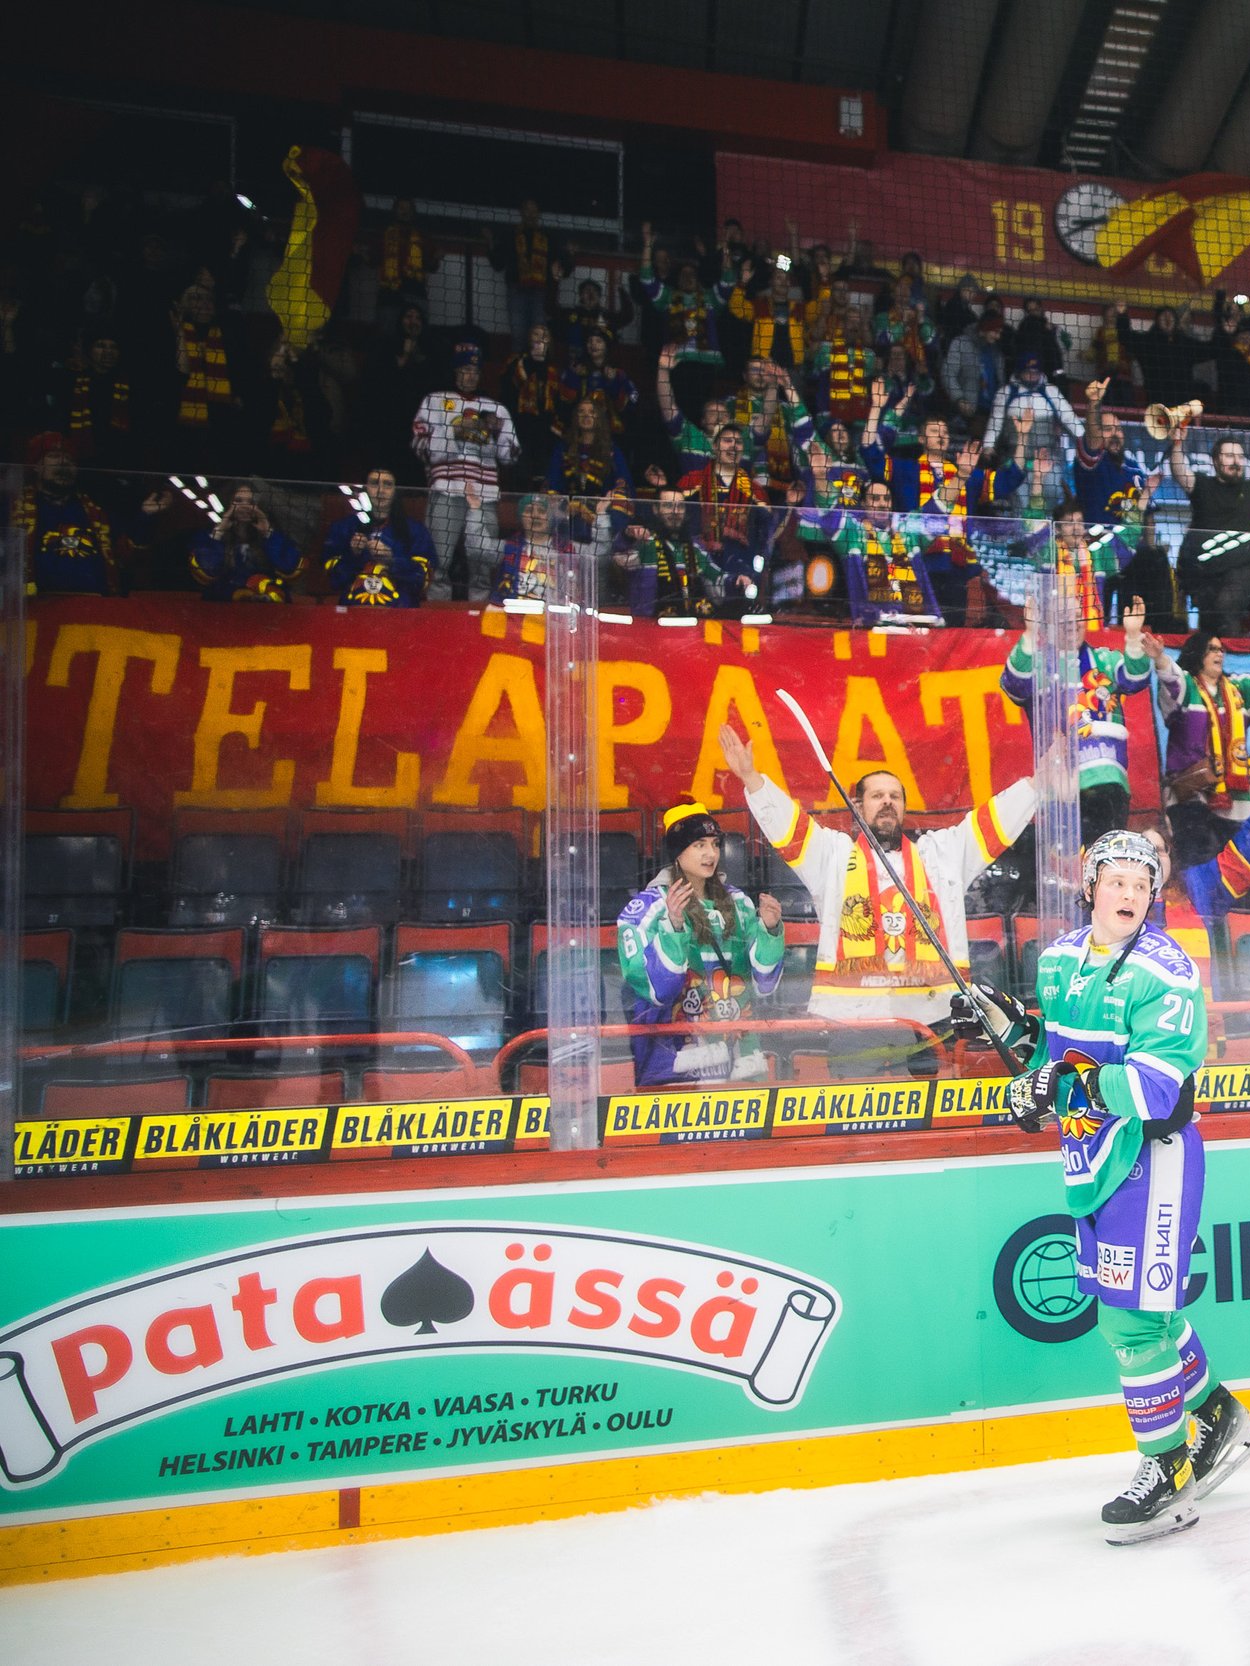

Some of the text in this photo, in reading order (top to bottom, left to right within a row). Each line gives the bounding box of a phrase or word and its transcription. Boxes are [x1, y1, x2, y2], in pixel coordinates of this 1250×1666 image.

[1157, 993, 1195, 1036] 20
[613, 1096, 762, 1131] BLÅKLÄDER
[780, 1087, 922, 1121] BLÅKLÄDER
[144, 1115, 319, 1153] BLÅKLÄDER
[340, 1105, 504, 1143] BLÅKLÄDER
[677, 1129, 746, 1141] WORKWEAR
[842, 1120, 907, 1131] WORKWEAR
[411, 1141, 486, 1154] WORKWEAR
[1155, 1203, 1173, 1257] HALTI
[51, 1243, 759, 1425] pata ässä
[223, 1381, 619, 1437] LAHTI KOTKA VAASA TURKU
[158, 1407, 674, 1477] HELSINKI TAMPERE JYVÄSKYLÄ OULU
